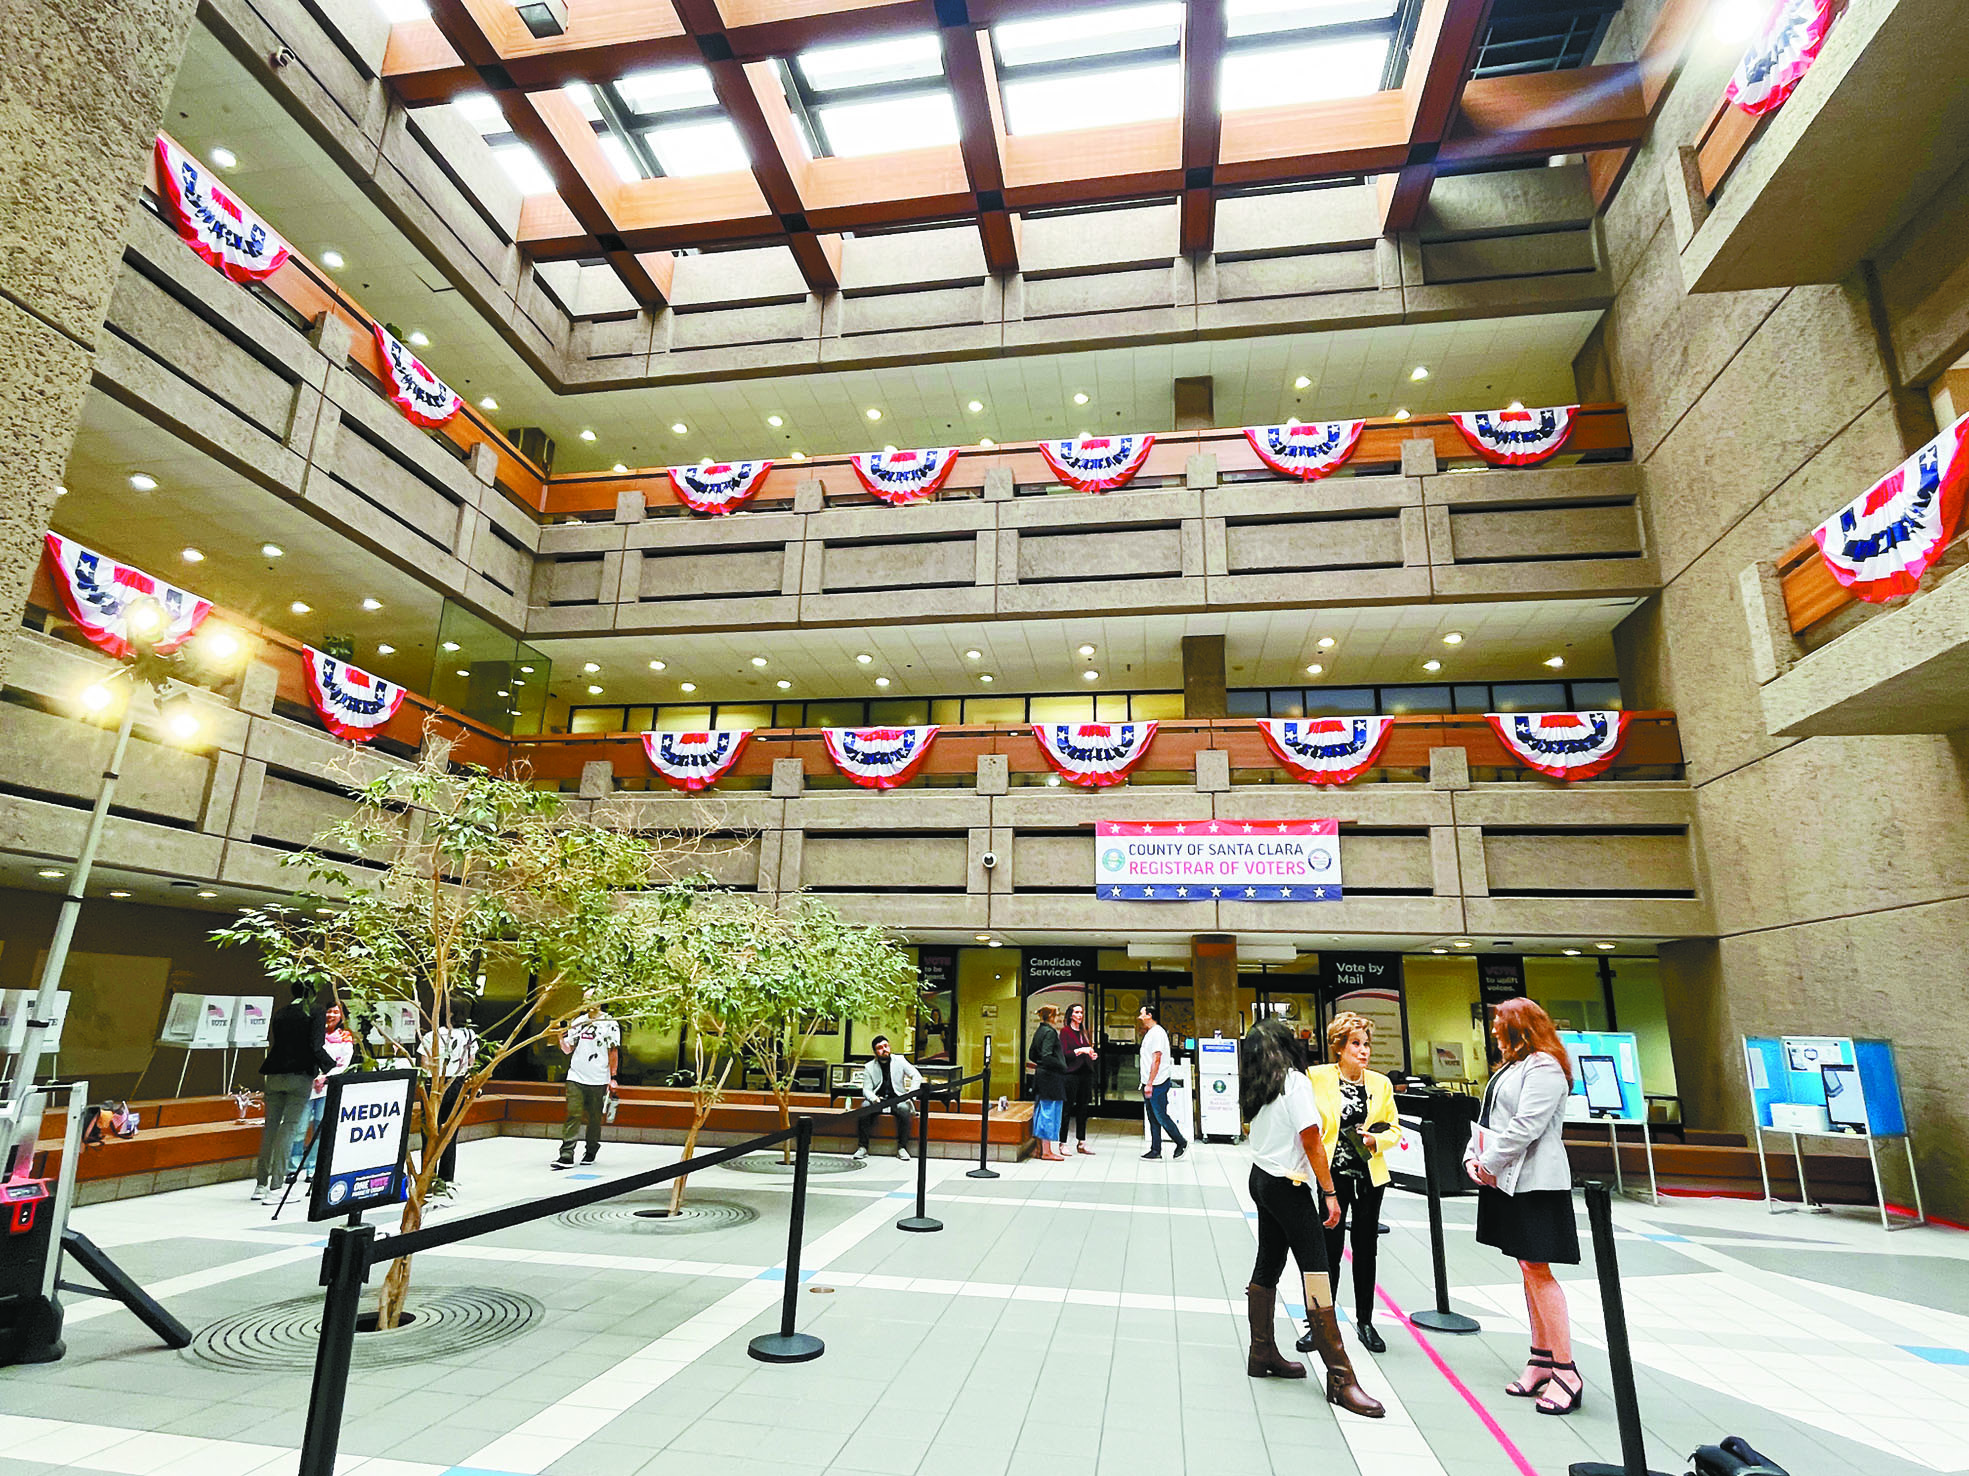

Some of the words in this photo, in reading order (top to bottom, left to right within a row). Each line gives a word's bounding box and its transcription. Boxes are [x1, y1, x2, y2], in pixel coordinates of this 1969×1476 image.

[1129, 843, 1183, 856] COUNTY
[1187, 843, 1205, 856] OF
[1209, 843, 1254, 856] SANTA
[1258, 843, 1304, 856] CLARA
[1129, 861, 1214, 875] REGISTRAR
[1220, 861, 1239, 875] OF
[1247, 861, 1306, 875] VOTERS
[1030, 957, 1082, 967] Candidate
[1030, 967, 1072, 977] Services
[1336, 962, 1366, 974] Vote
[1368, 962, 1385, 976] by
[1337, 974, 1364, 985] Mail
[340, 1101, 401, 1123] MEDIA
[349, 1122, 389, 1143] DAY
